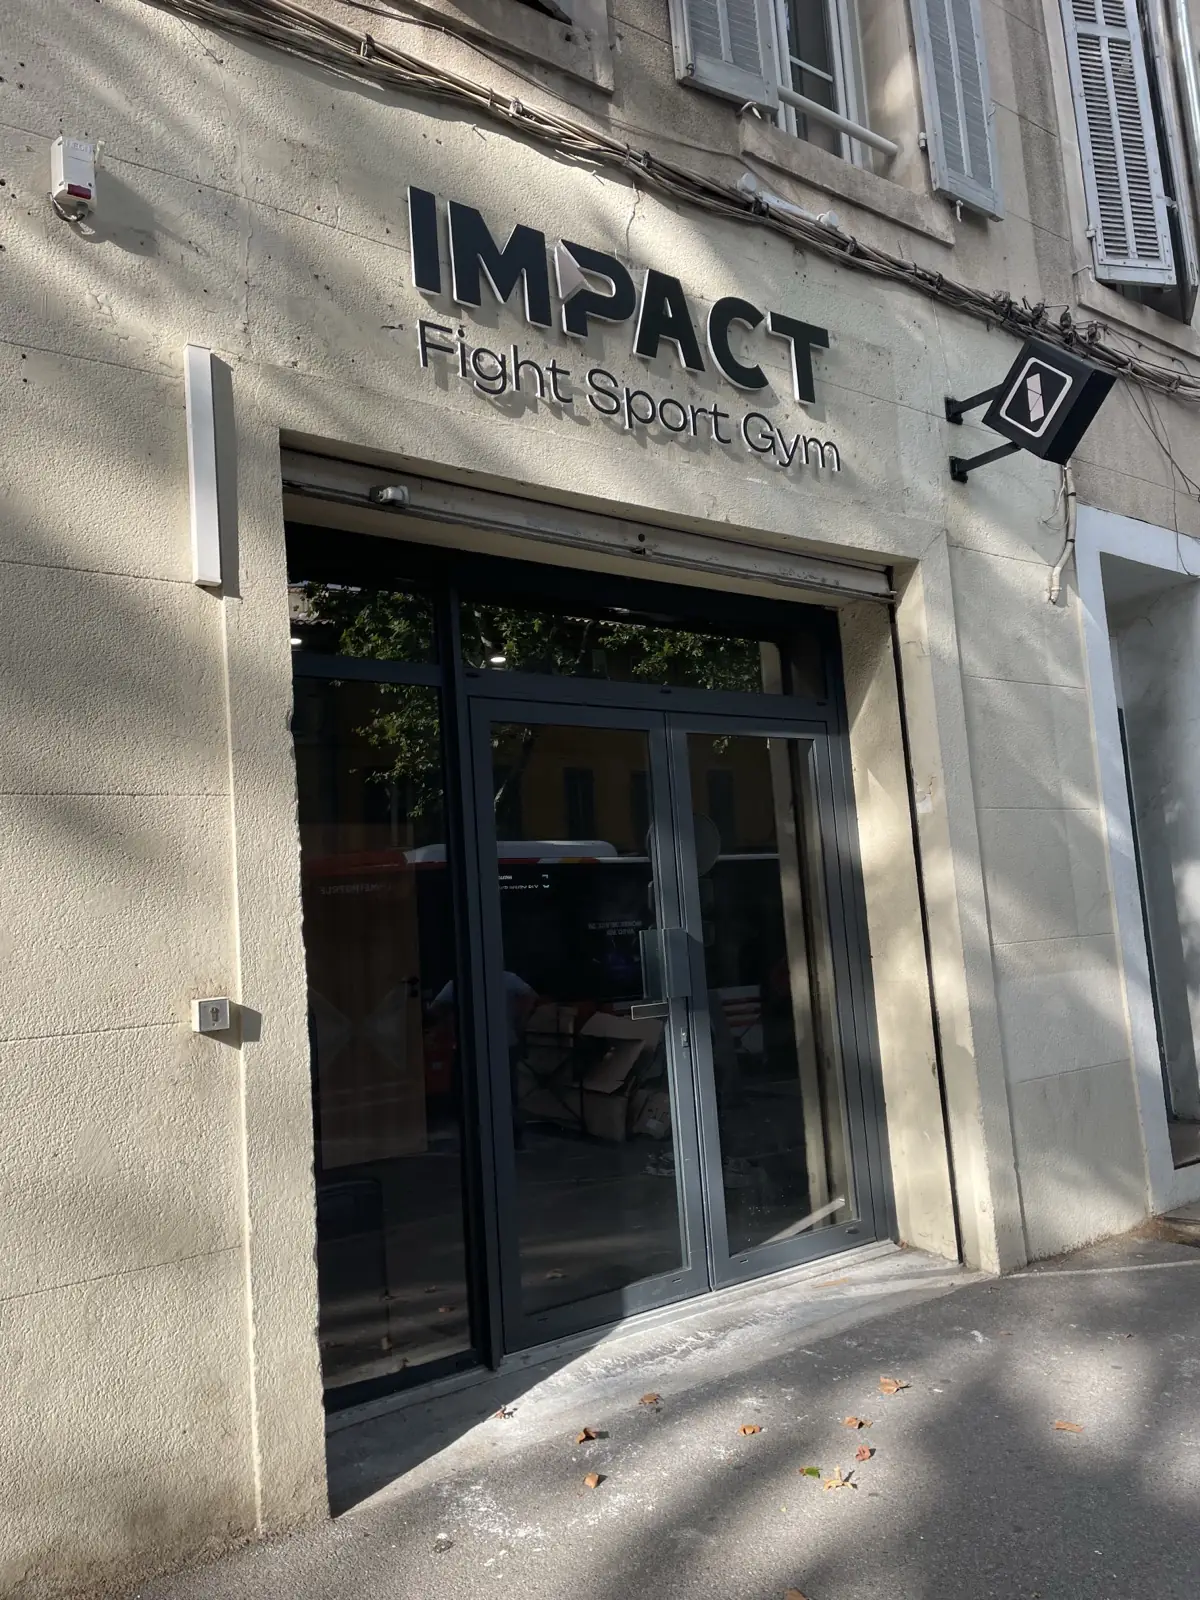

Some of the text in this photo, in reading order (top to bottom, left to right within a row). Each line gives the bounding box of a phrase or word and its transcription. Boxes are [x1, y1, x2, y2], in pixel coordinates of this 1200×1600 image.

[407, 184, 830, 405] IMPACT
[416, 318, 842, 472] Fight Sport Gym
